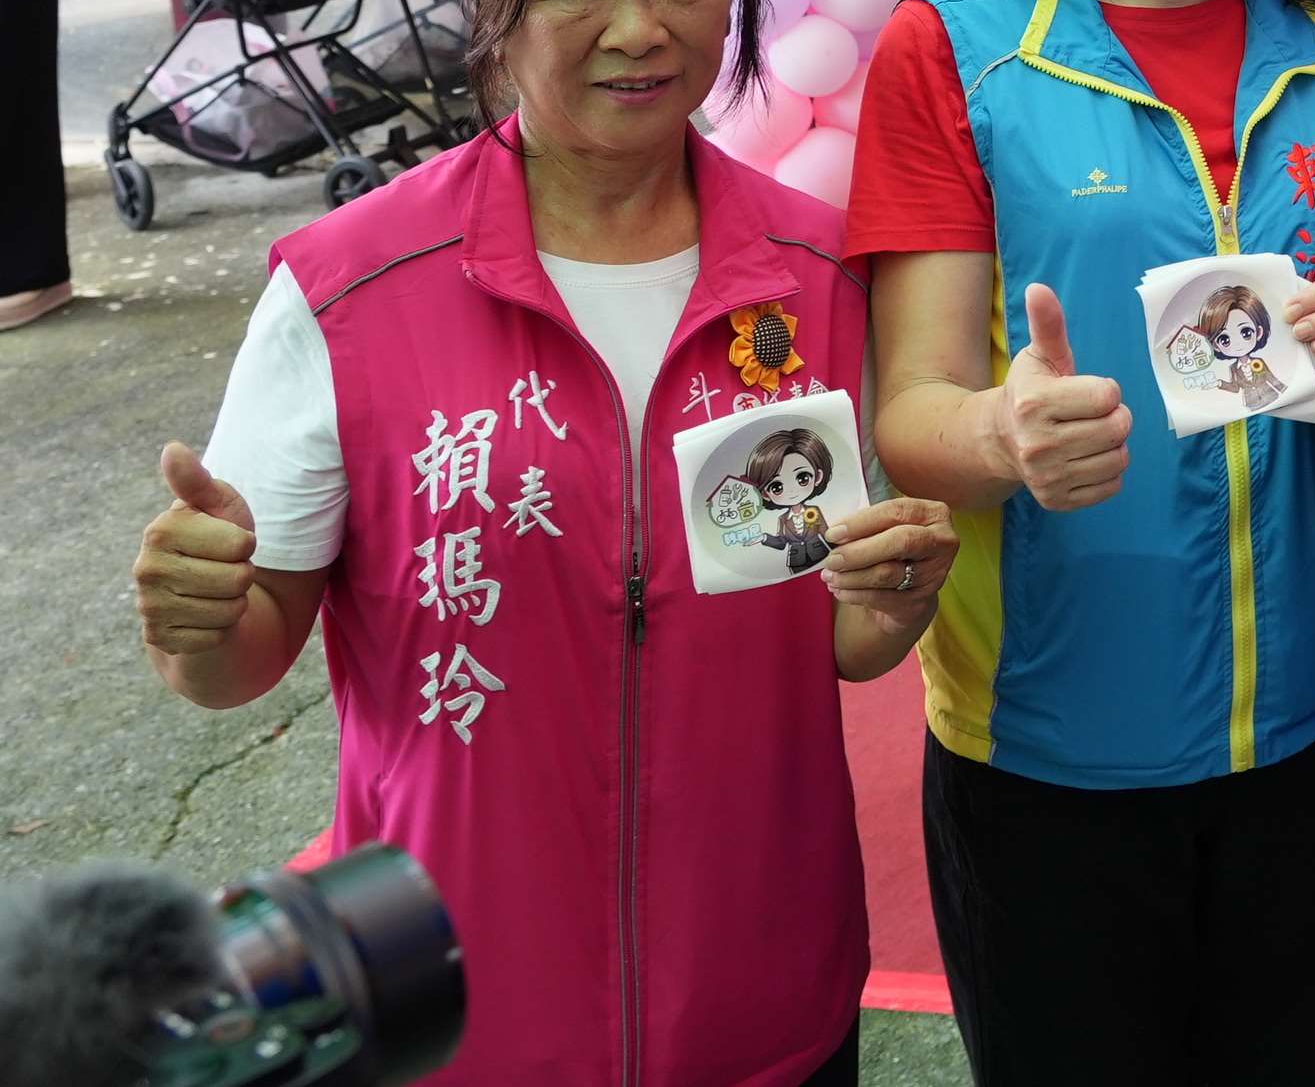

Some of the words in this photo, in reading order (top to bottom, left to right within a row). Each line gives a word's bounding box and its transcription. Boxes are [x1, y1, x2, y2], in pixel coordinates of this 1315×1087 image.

[411, 409, 507, 746] 賴瑪玲
[507, 370, 568, 538] 代表
